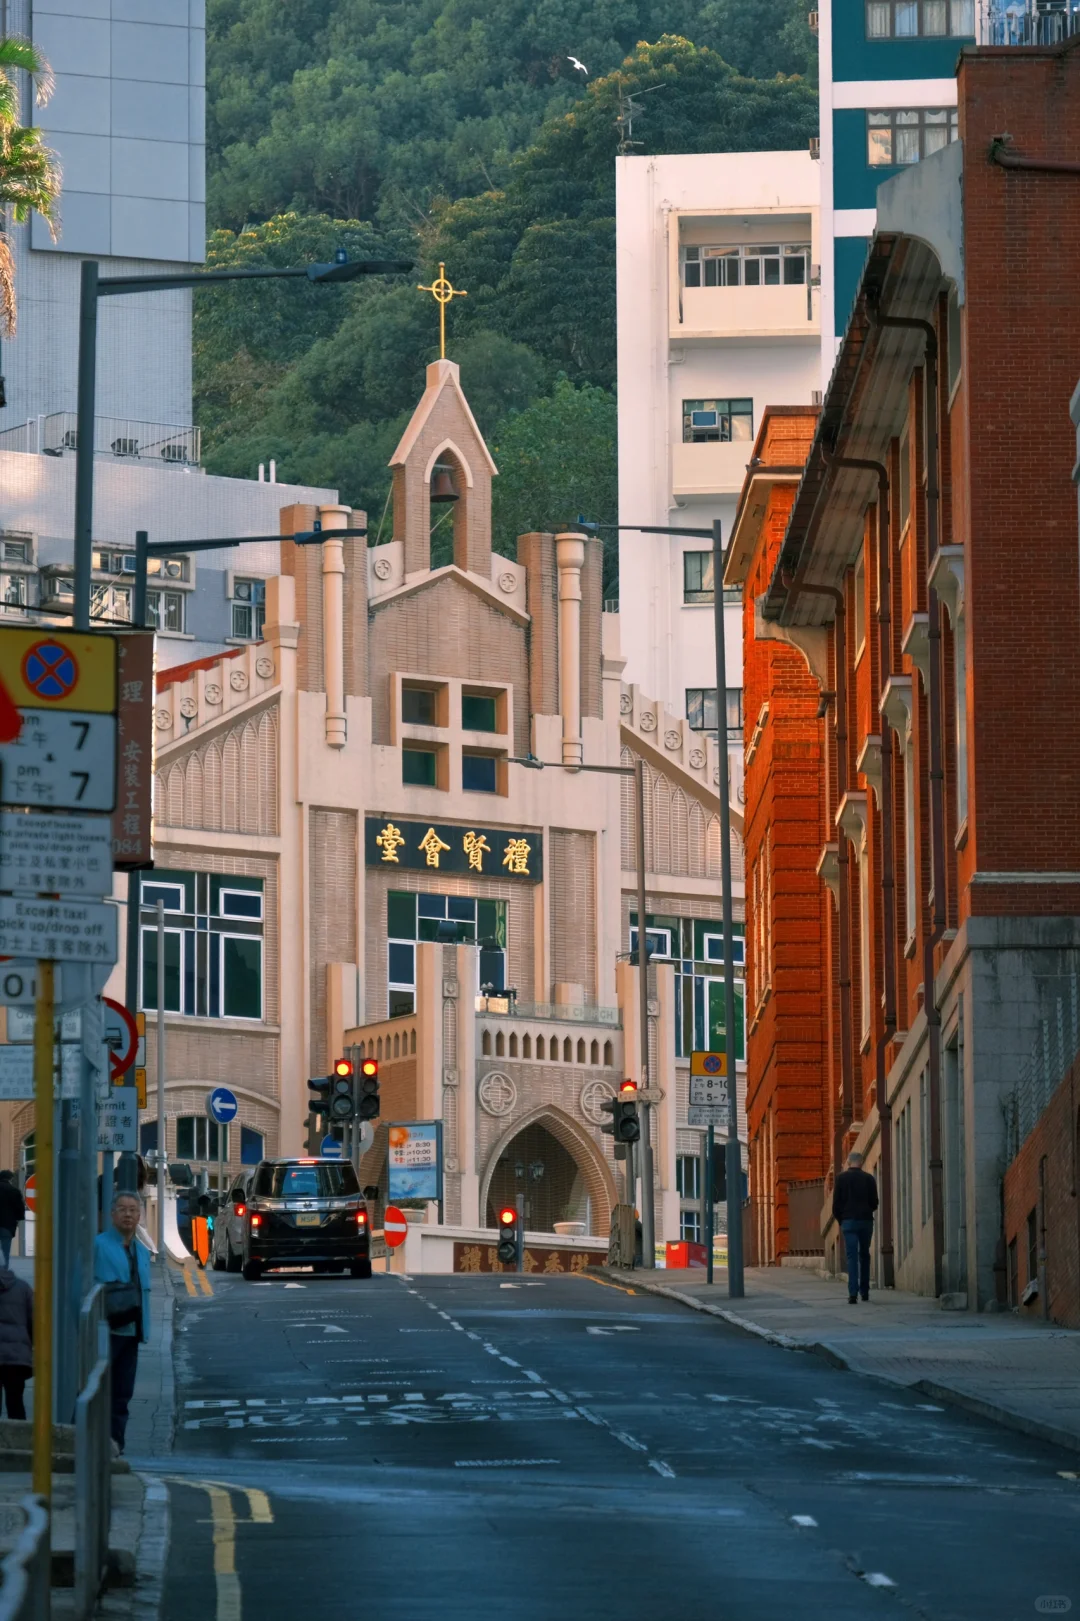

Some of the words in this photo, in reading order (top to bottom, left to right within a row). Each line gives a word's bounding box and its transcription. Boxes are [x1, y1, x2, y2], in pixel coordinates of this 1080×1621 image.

[122, 680, 144, 703] 理
[70, 720, 90, 751] 7
[17, 765, 40, 778] pm
[10, 781, 47, 798] 下午
[70, 771, 90, 801] 7
[122, 740, 143, 835] 安裝工程
[15, 904, 61, 921] Except
[63, 907, 88, 921] taxi
[0, 919, 25, 931] pick
[84, 924, 104, 935] off
[96, 1114, 132, 1128] 證者
